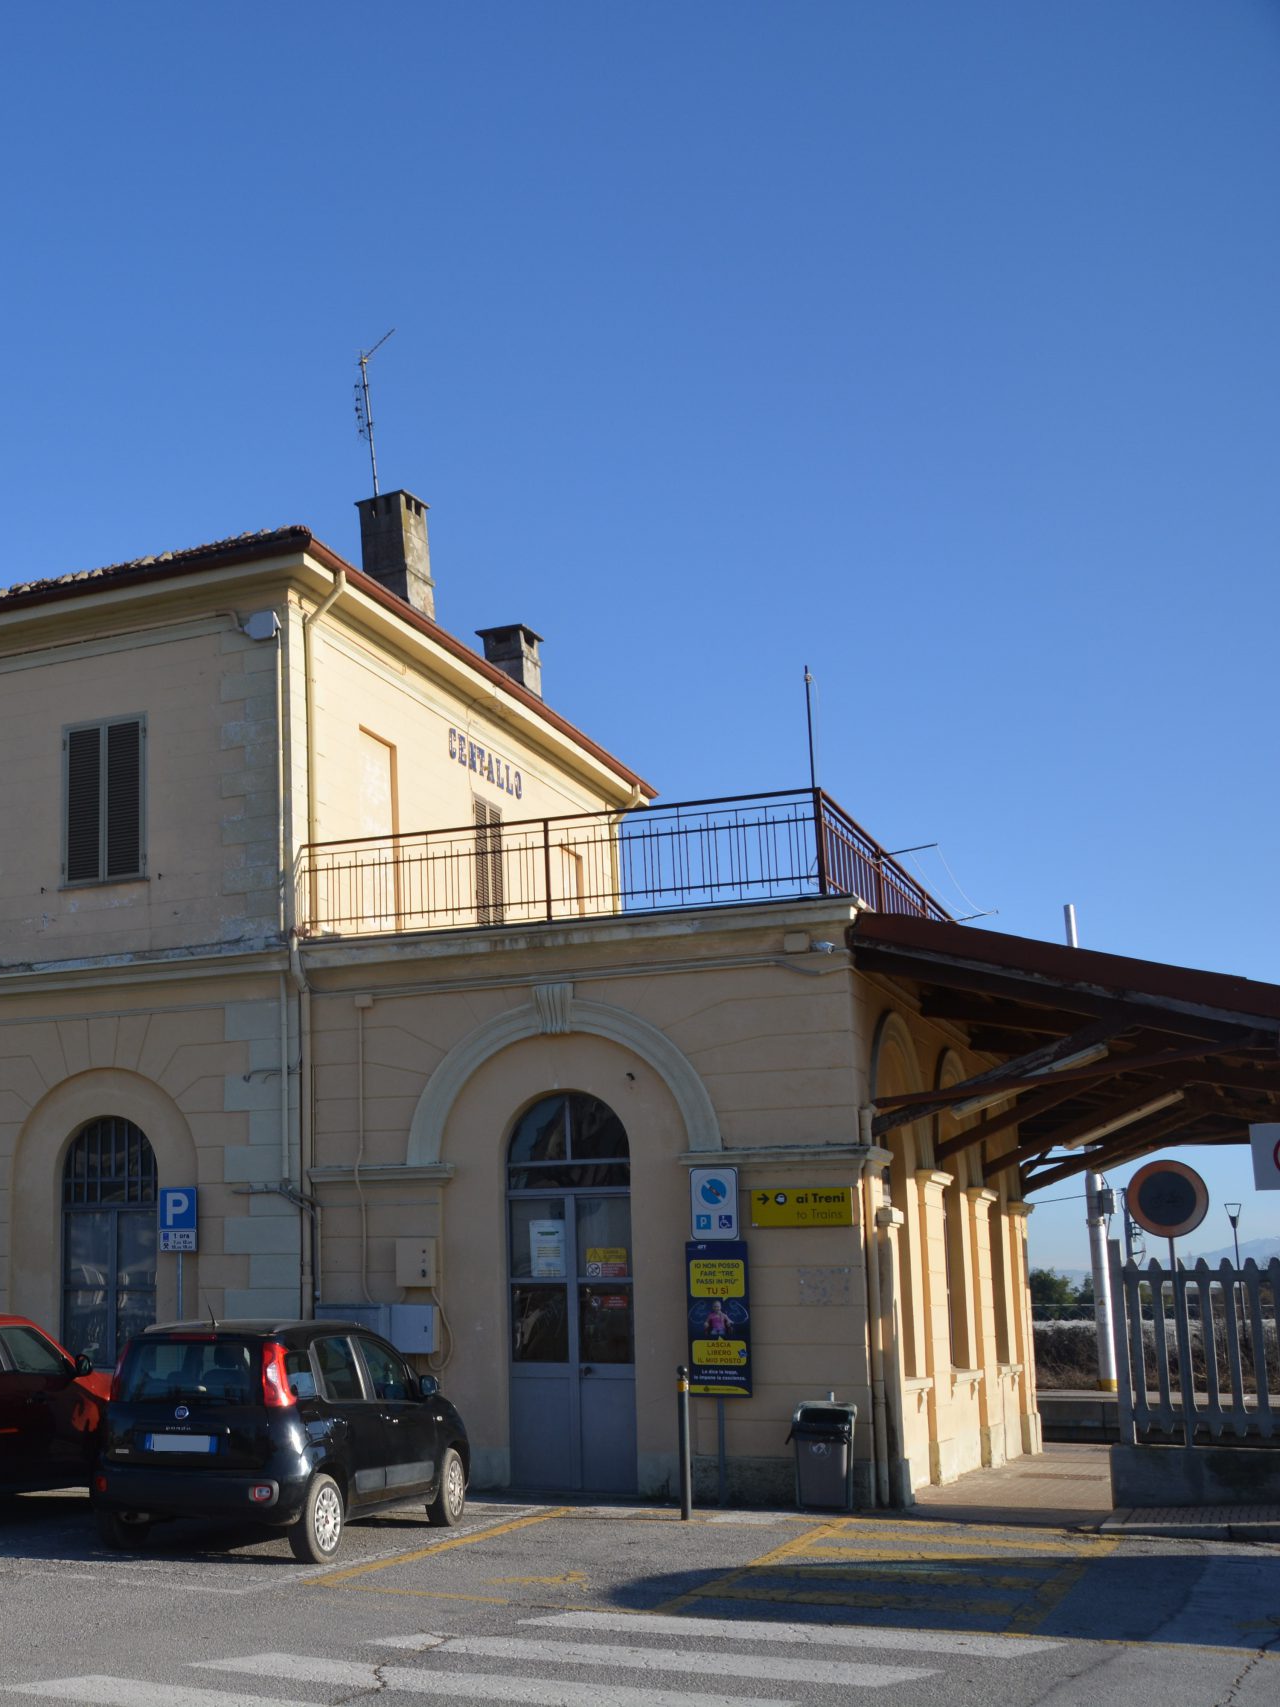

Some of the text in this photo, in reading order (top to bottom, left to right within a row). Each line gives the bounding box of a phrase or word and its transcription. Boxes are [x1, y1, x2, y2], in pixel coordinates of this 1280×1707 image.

[448, 727, 522, 800] CENTALLO
[795, 1192, 845, 1204] ai Treni
[166, 1192, 189, 1226] P
[796, 1208, 843, 1220] to Trains
[706, 1287, 718, 1295] TU
